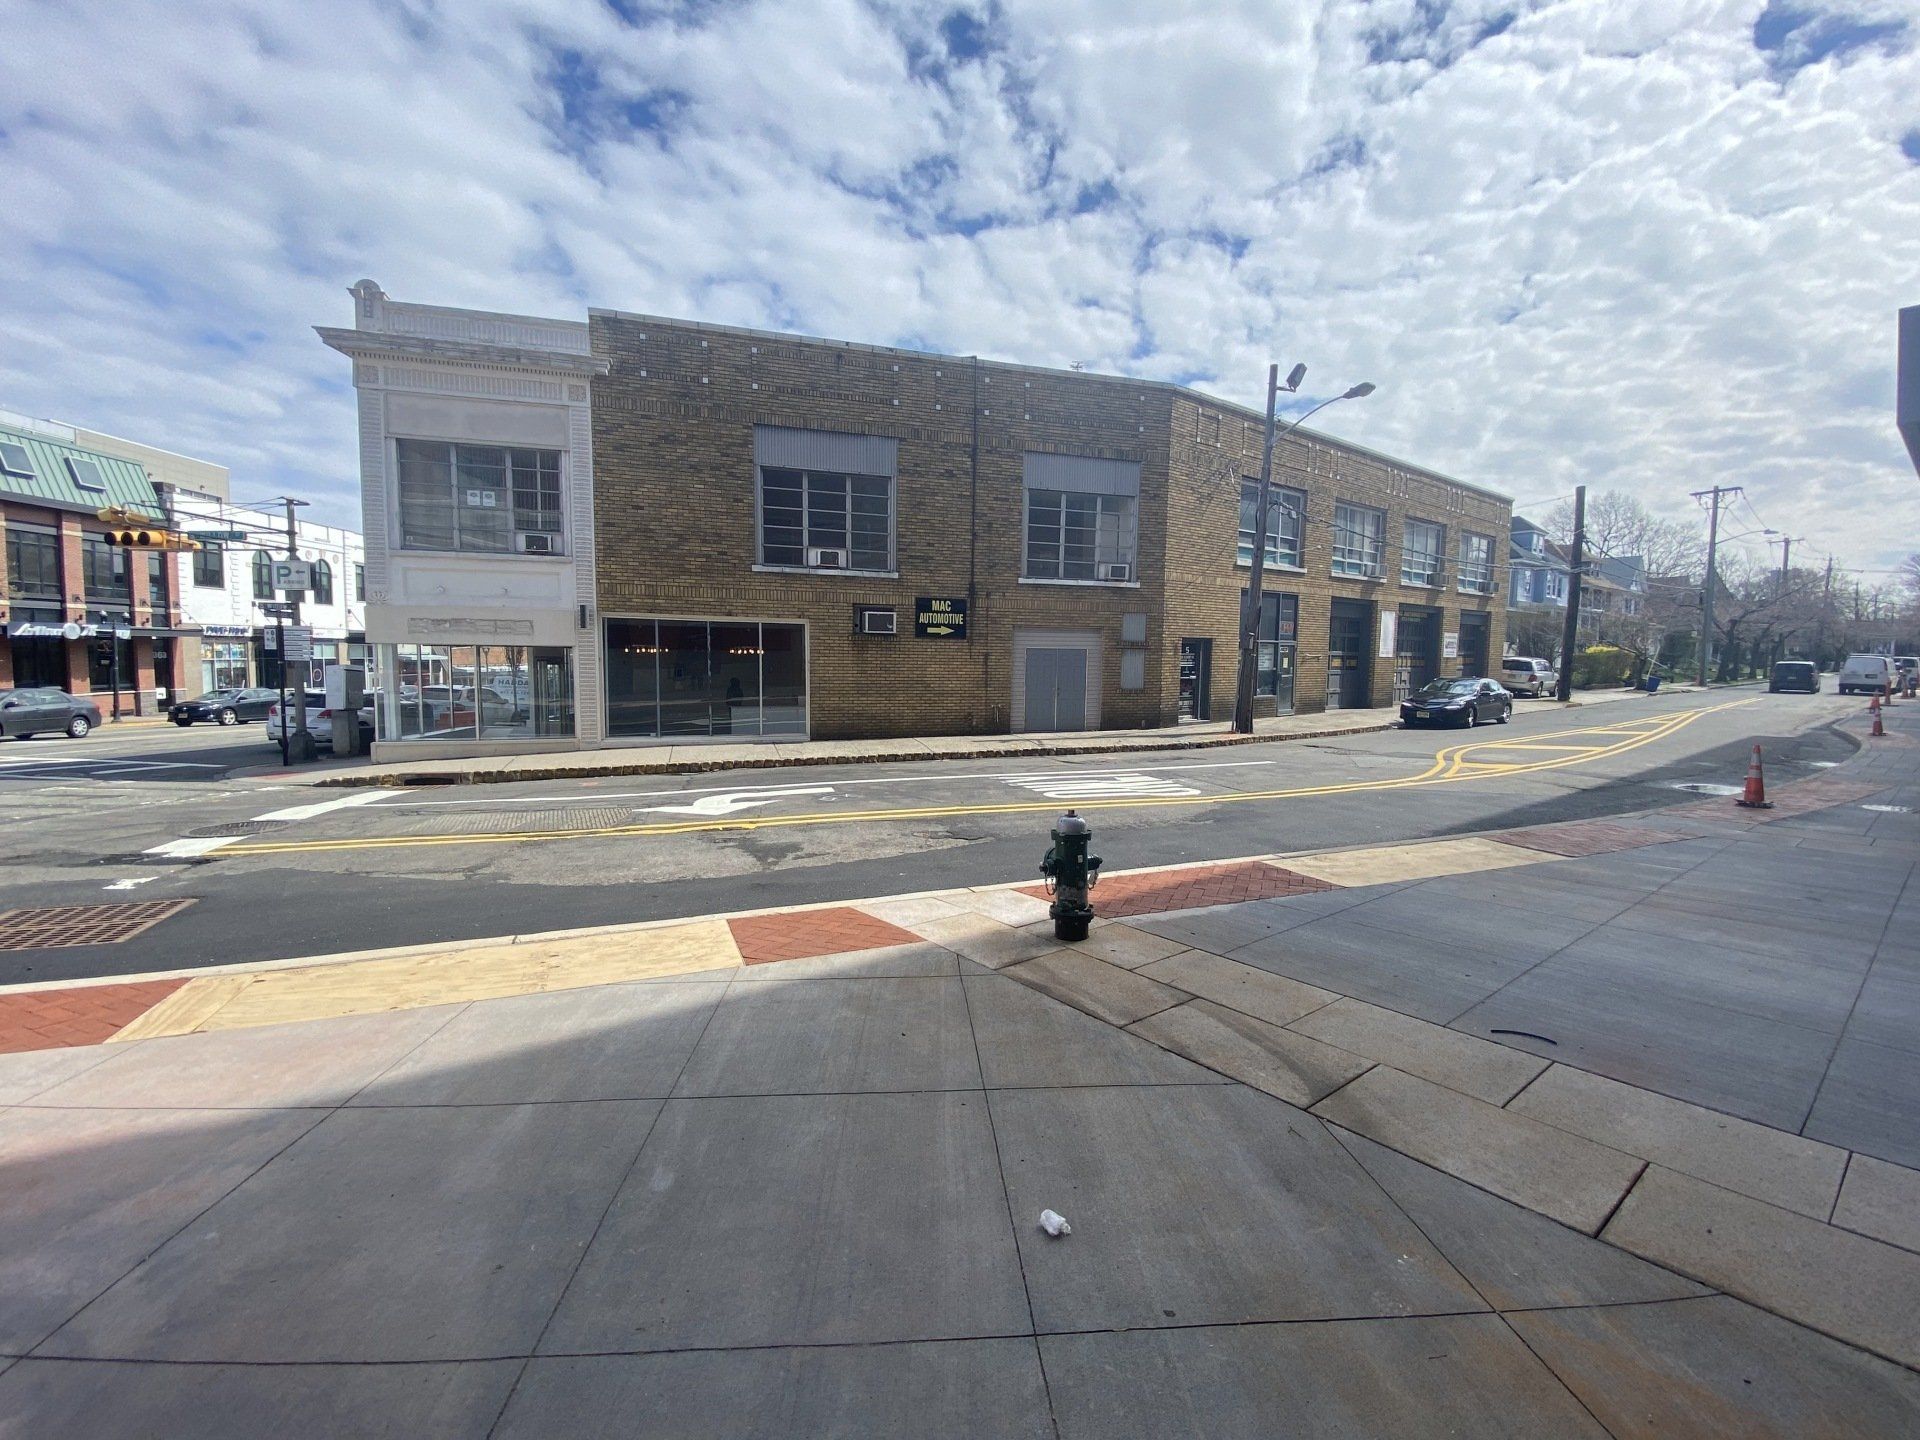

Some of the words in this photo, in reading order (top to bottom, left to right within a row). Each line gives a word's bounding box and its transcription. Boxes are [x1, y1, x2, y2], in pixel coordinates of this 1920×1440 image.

[931, 600, 952, 611] MAC
[919, 612, 964, 625] AUTOMOTIVE
[1185, 646, 1190, 654] 5
